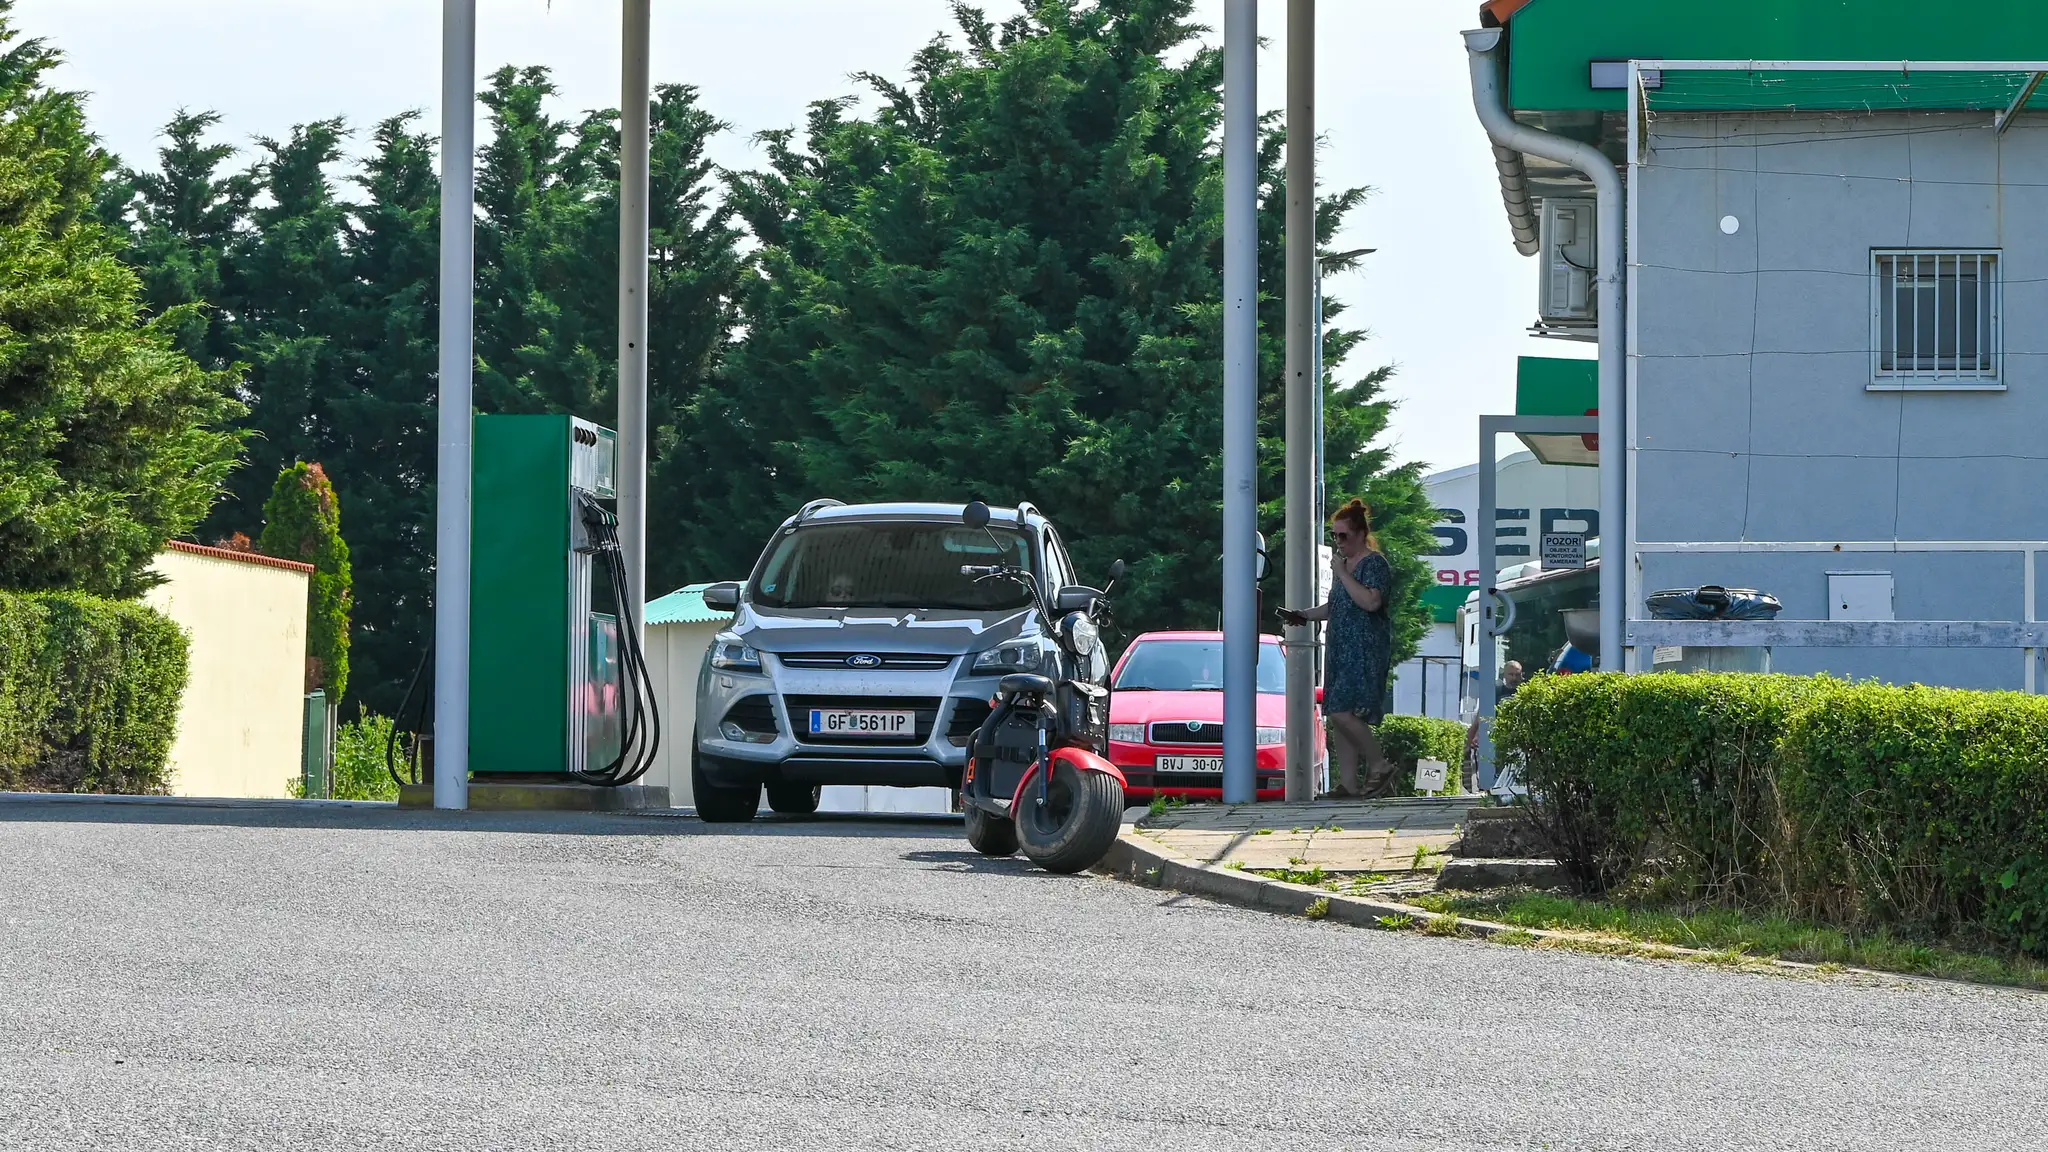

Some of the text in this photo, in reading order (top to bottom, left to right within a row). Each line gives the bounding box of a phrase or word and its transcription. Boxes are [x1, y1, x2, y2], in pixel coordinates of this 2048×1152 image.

[1546, 537, 1581, 545] POZOR!
[853, 656, 874, 665] Ford
[828, 714, 906, 731] GF 561IP
[1162, 758, 1184, 771] BVJ
